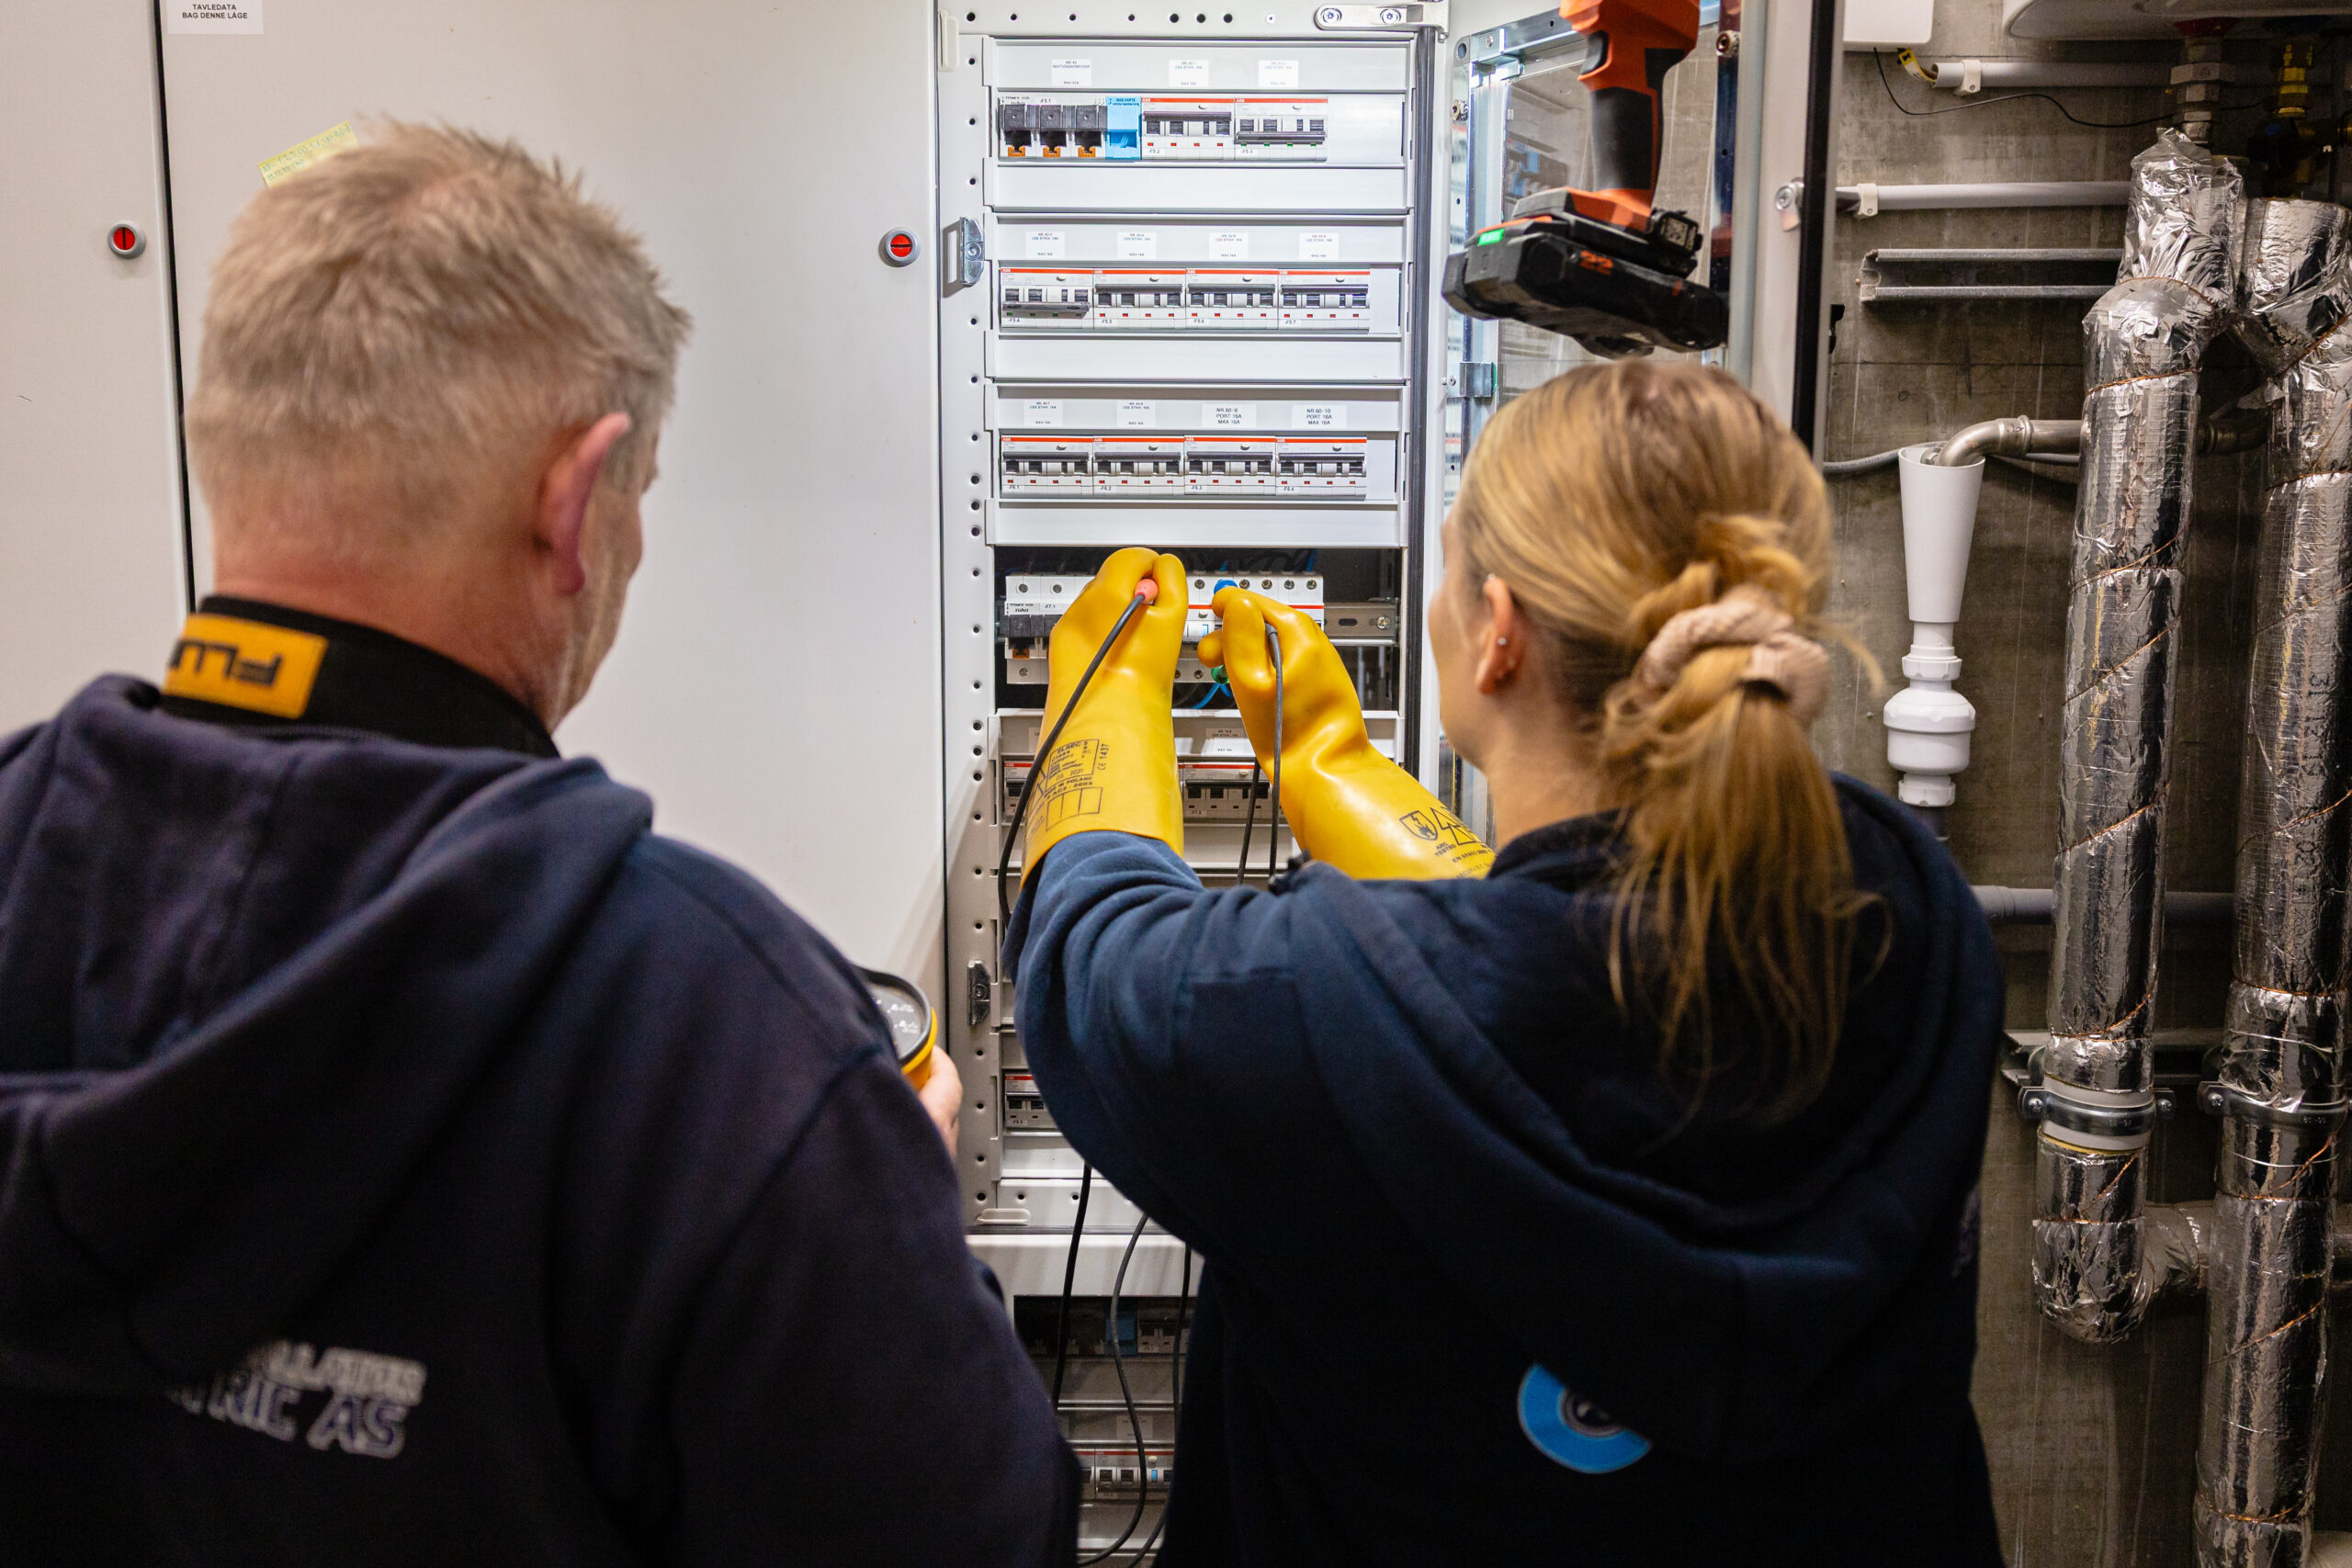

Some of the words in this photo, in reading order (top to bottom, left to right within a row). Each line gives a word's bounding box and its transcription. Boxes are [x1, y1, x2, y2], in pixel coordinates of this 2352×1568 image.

[1057, 740, 1081, 754] ELSEC
[1066, 776, 1093, 784] POLAND
[1435, 844, 1456, 857] TESTED
[1452, 855, 1462, 863] EN
[306, 1387, 409, 1461] AS
